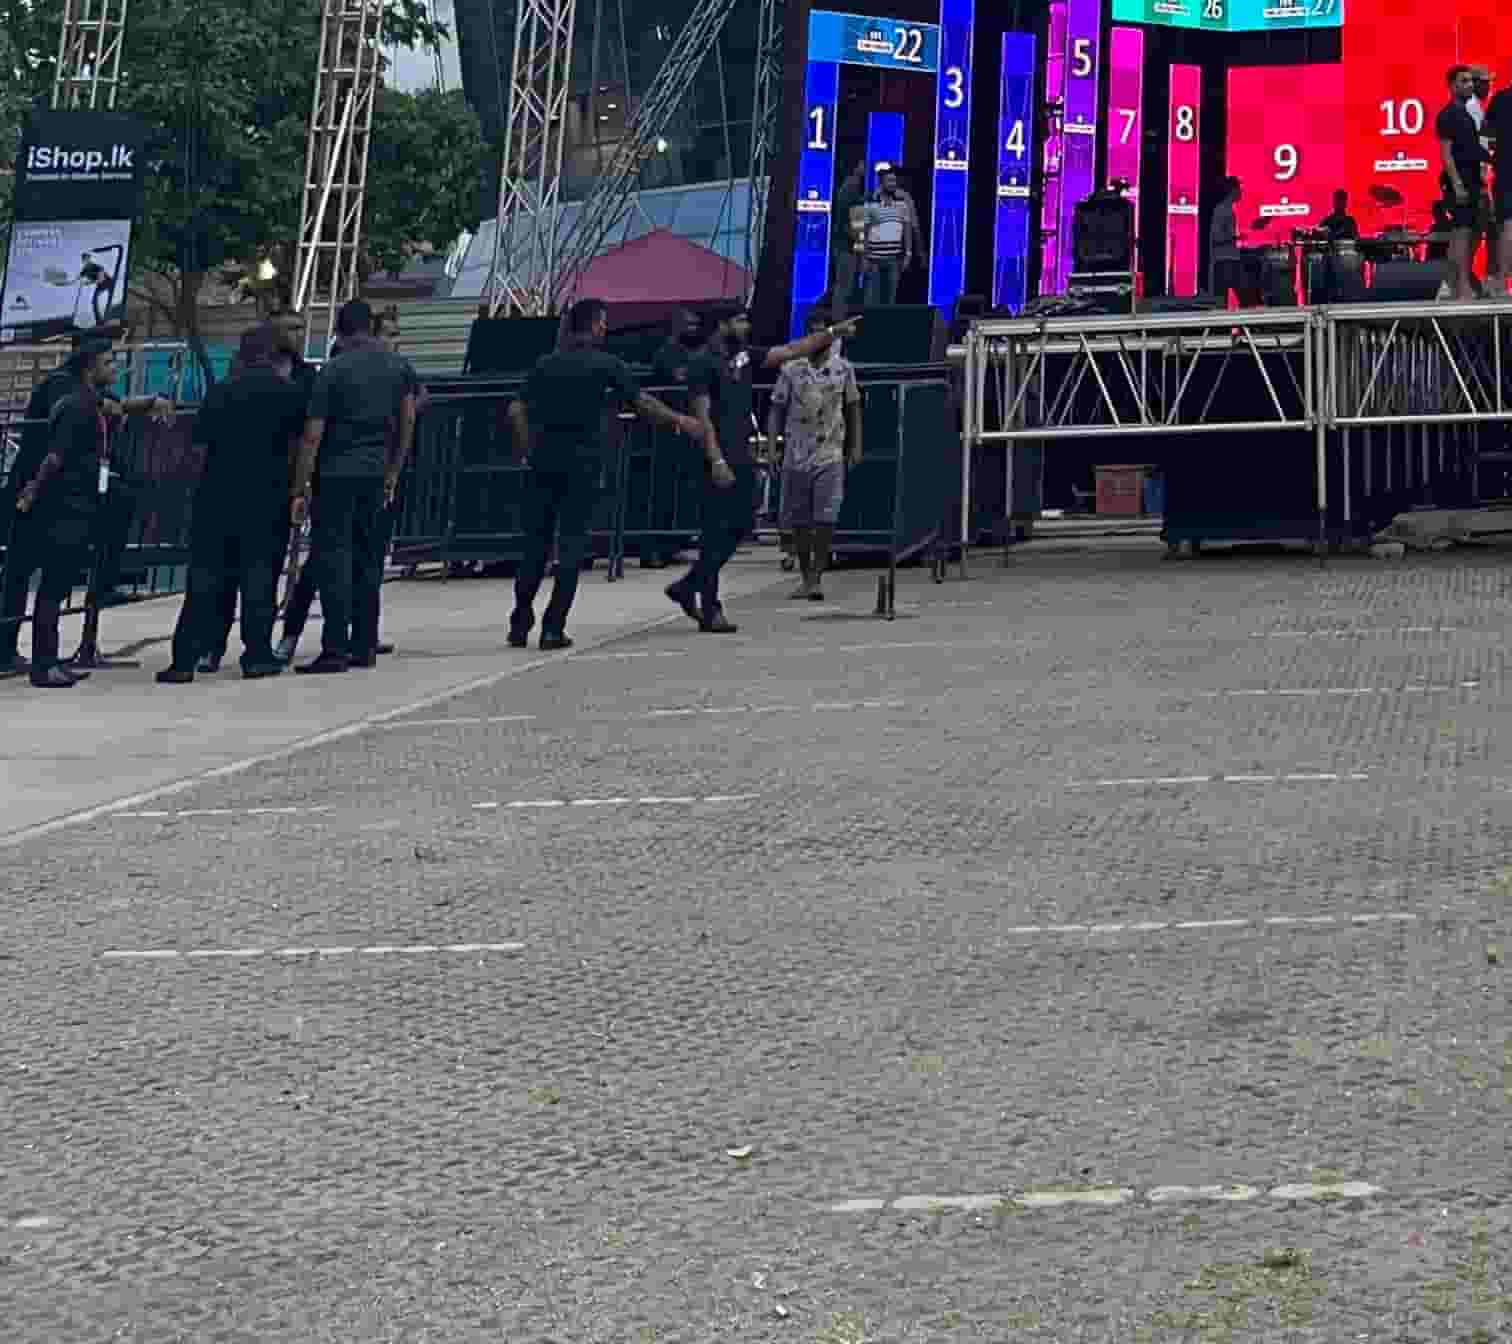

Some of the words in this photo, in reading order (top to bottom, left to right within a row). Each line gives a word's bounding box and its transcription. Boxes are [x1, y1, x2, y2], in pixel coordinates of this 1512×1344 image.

[893, 28, 922, 62] 22
[1073, 39, 1091, 76] 5
[945, 68, 963, 108] 3
[808, 107, 827, 149] 1
[1119, 109, 1136, 145] 7
[1176, 105, 1194, 140] 8
[1379, 99, 1424, 135] 10
[27, 144, 134, 171] iShop.lk
[1005, 120, 1025, 159] 4
[1273, 143, 1298, 181] 9
